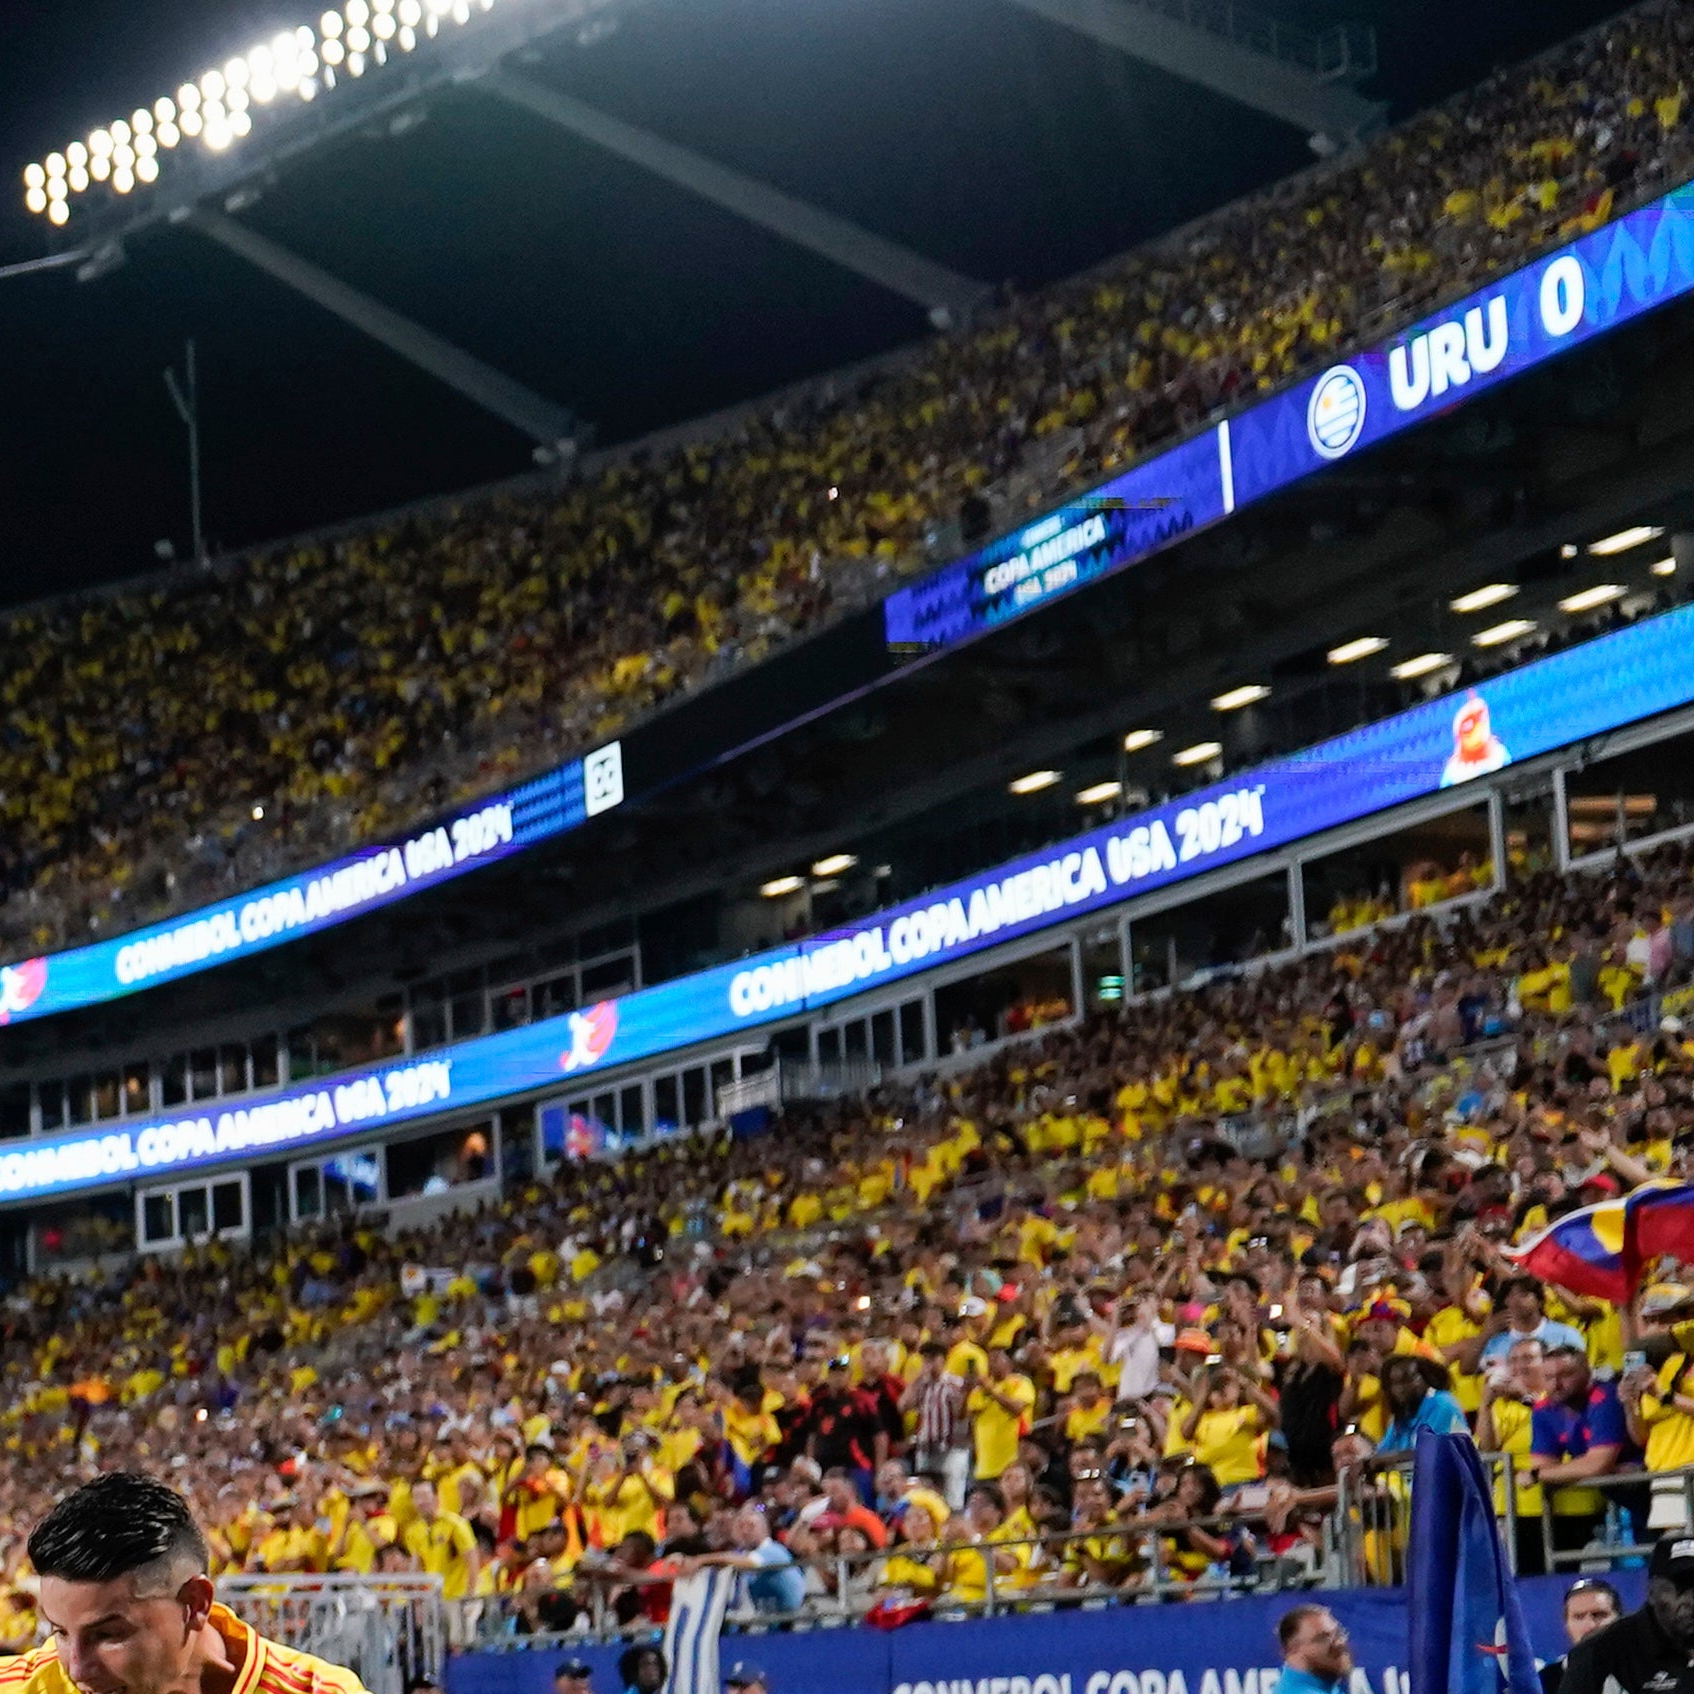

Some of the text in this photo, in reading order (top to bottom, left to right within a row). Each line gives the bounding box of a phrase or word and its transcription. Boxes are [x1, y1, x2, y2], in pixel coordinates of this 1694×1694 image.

[1389, 255, 1584, 411] URU 0
[116, 803, 515, 984] CONMEBOL COPA AMERICA USA 2024
[729, 787, 1266, 1017] CONMEBOL COPA AMERICA USA 2024
[137, 1116, 215, 1167] COPA
